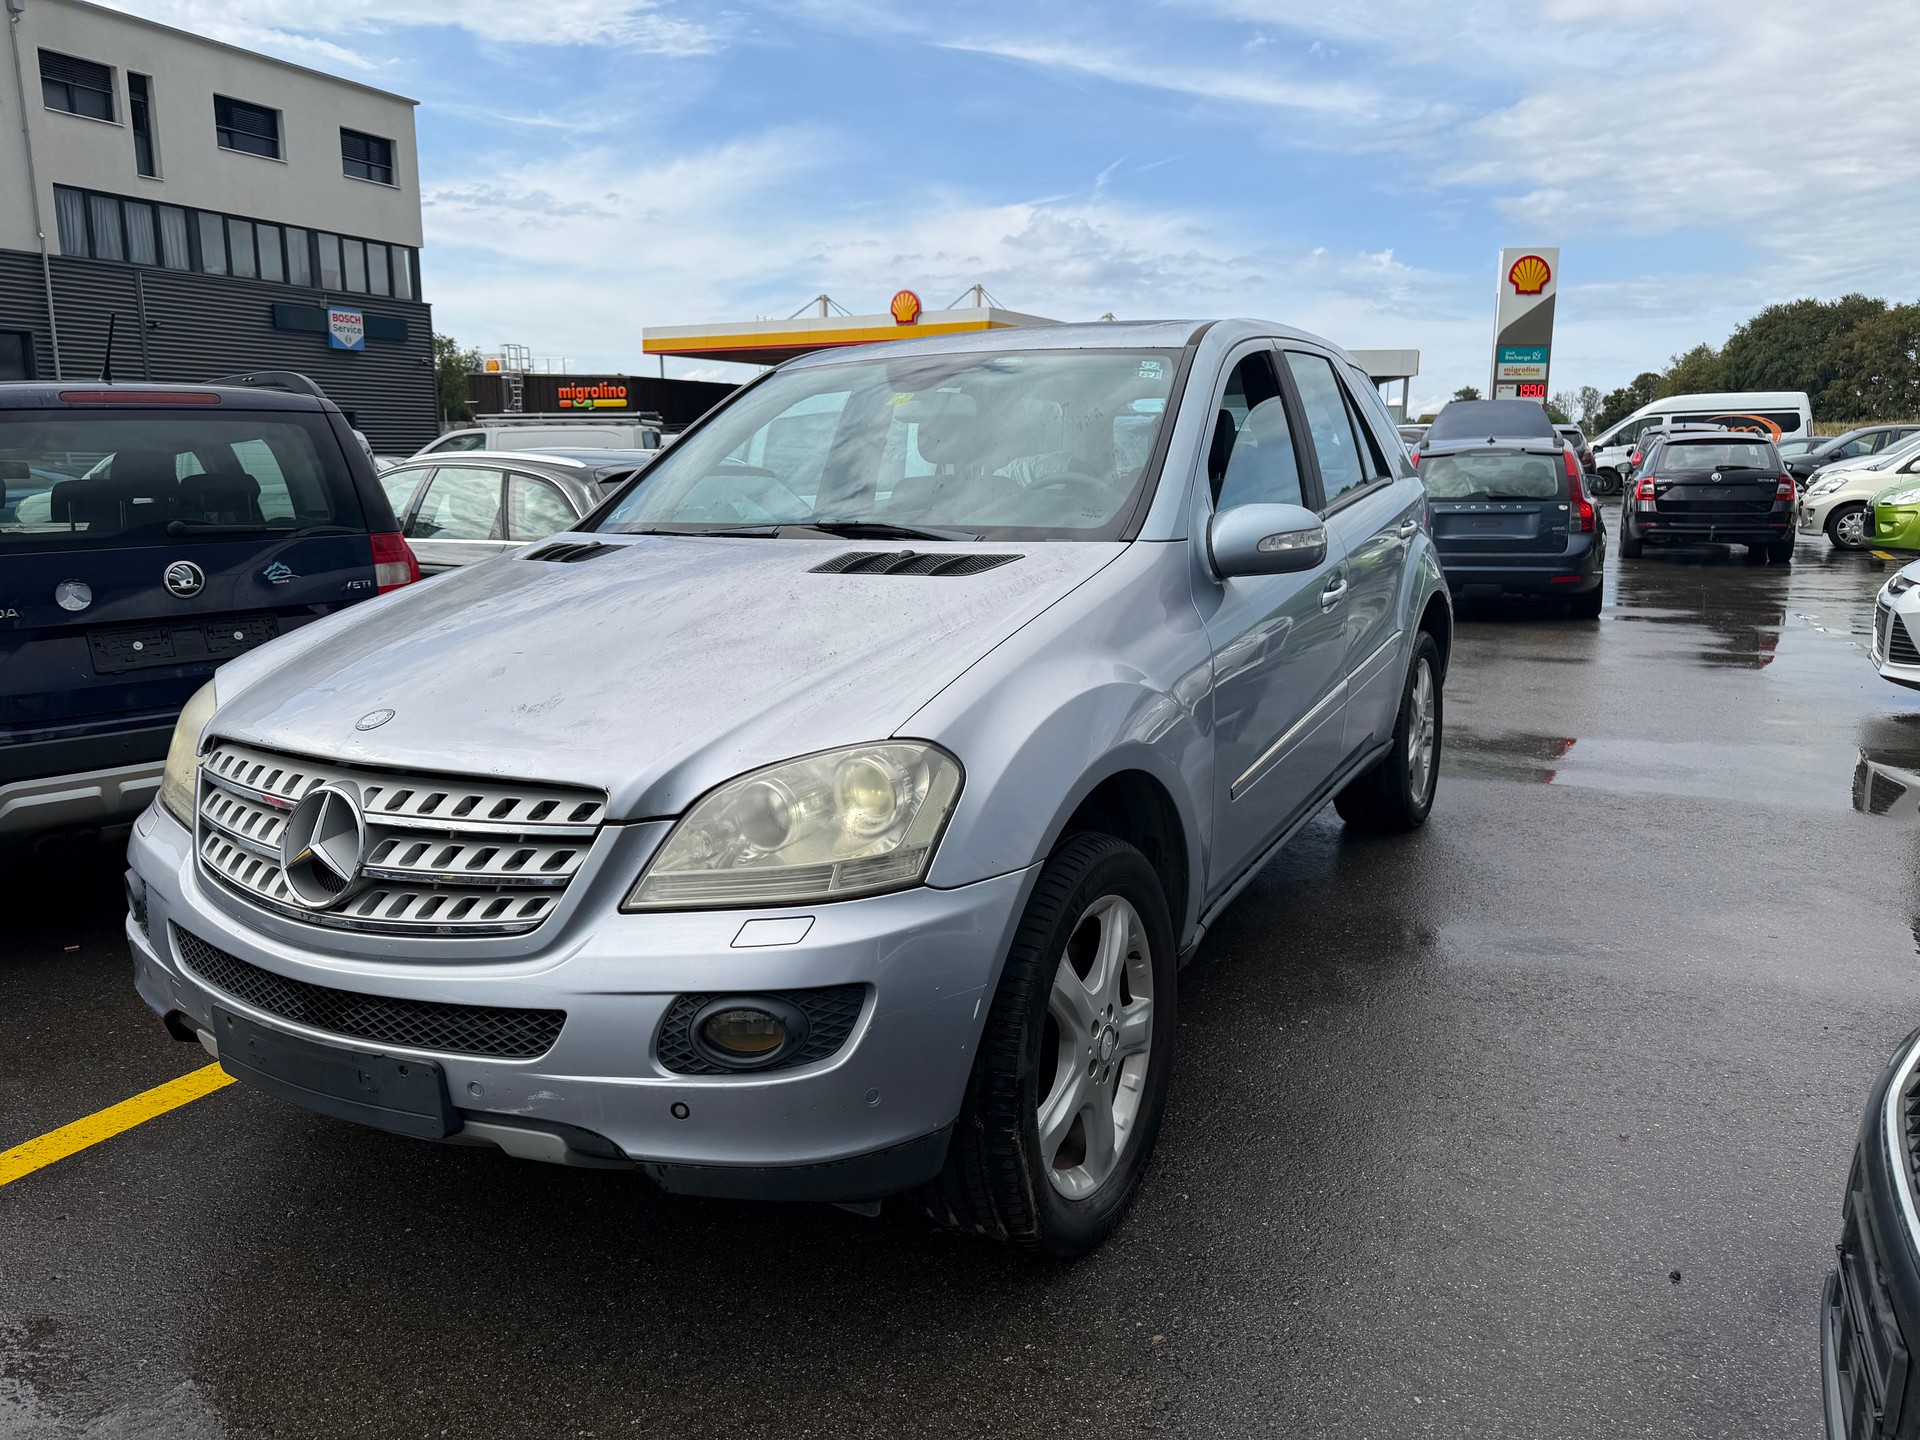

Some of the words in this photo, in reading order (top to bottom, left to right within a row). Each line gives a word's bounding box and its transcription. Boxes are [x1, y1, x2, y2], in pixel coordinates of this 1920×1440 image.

[332, 313, 361, 325] BOSCH
[333, 324, 362, 335] Service
[1504, 366, 1541, 374] migrolino
[558, 381, 627, 404] migrolino
